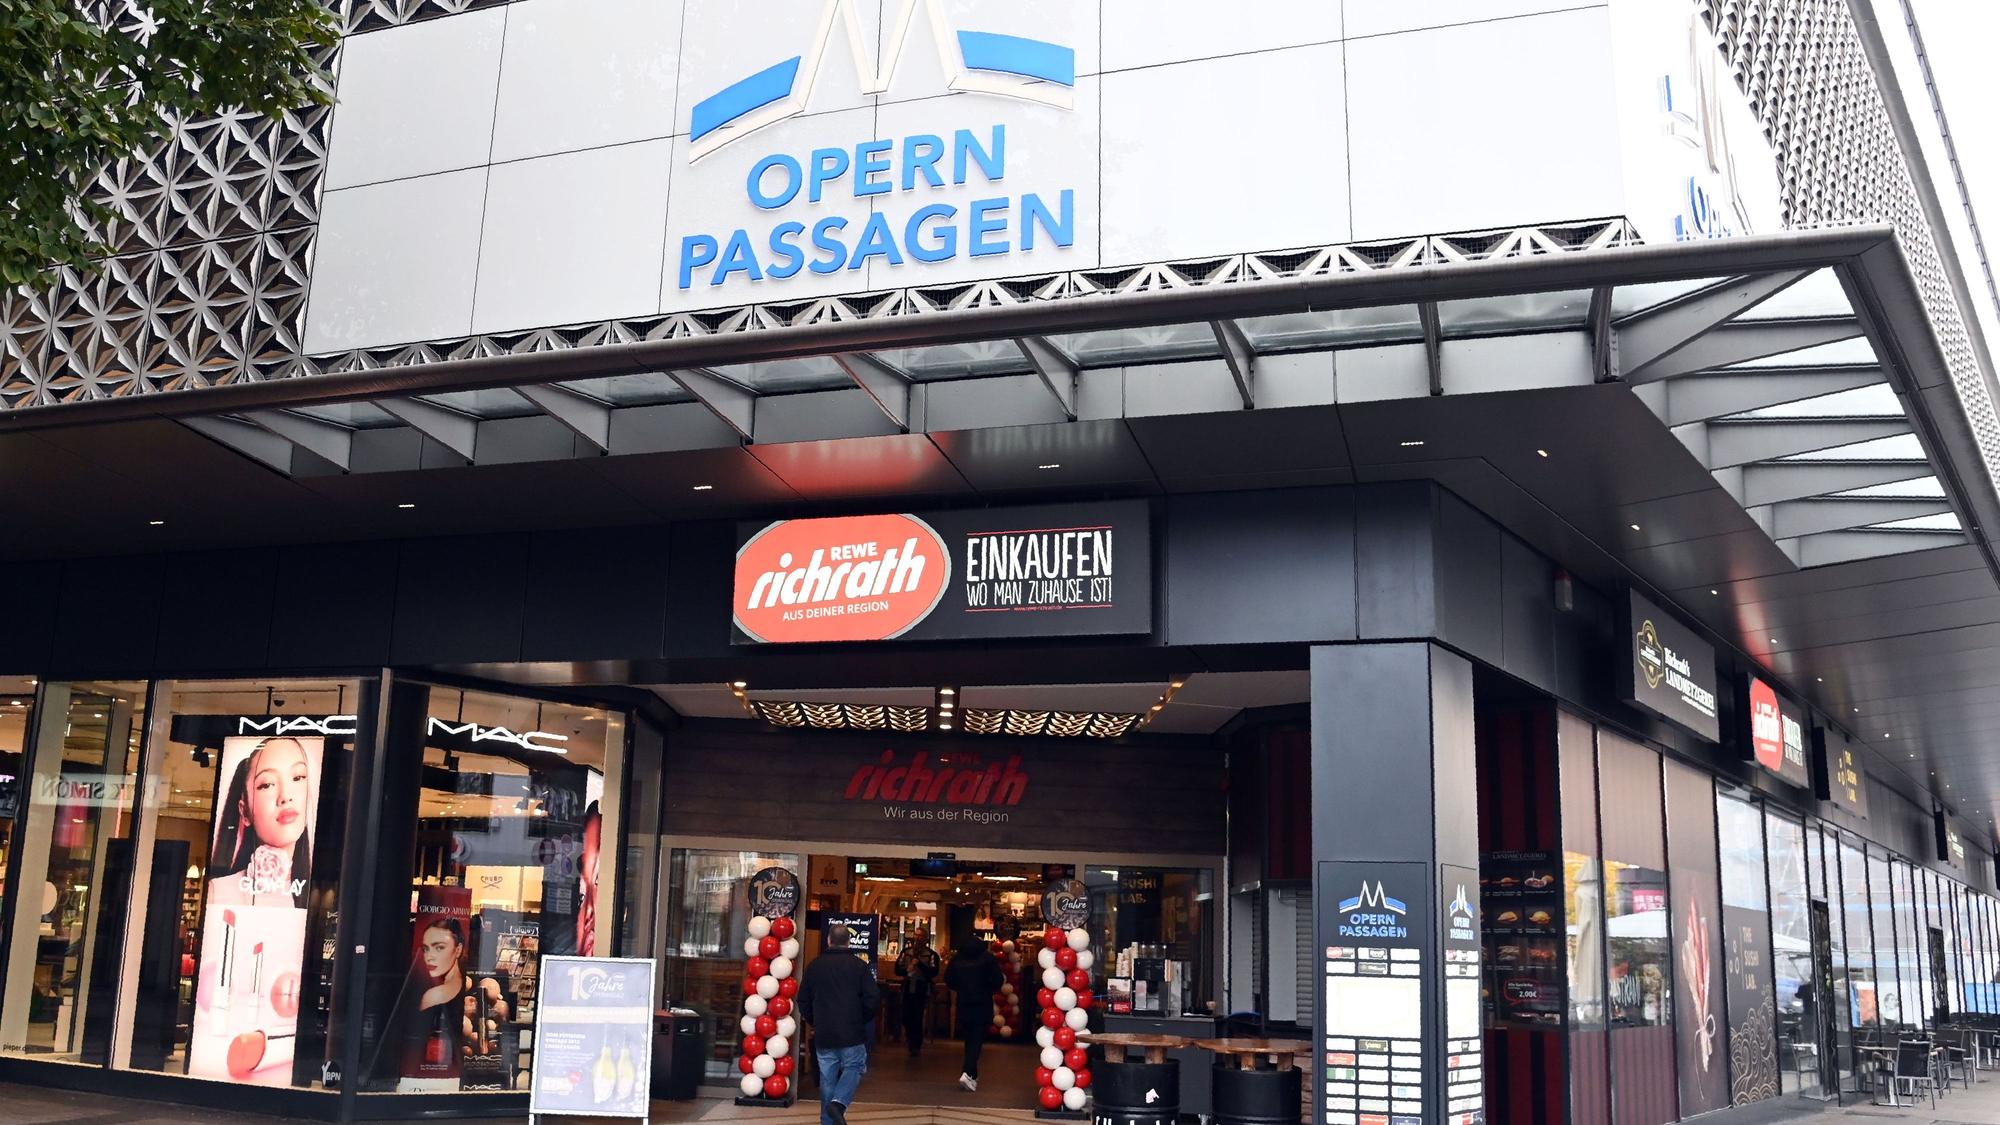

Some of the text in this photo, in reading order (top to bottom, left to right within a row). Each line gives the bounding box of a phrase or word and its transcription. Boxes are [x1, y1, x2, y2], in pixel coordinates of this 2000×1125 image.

[747, 124, 1005, 211] OPERN
[678, 189, 1074, 290] PASSAGEN
[830, 542, 878, 561] REWE
[966, 530, 1112, 582] EINKAUFEN
[747, 537, 926, 610] richrath
[966, 577, 1112, 606] WO MAN ZUHAUSE IST!
[782, 601, 889, 621] AUS DEINER REGION
[844, 748, 1030, 806] richrath
[884, 806, 1009, 825] Wir aus der Region
[768, 886, 793, 900] Jahre
[1120, 878, 1157, 889] SUSHI
[419, 904, 450, 915] GIORGIO
[1061, 897, 1087, 911] Jahre
[1350, 913, 1396, 925] OPERN
[848, 933, 869, 945] ahre
[1339, 926, 1407, 938] PASSAGEN
[588, 976, 625, 994] Jahre
